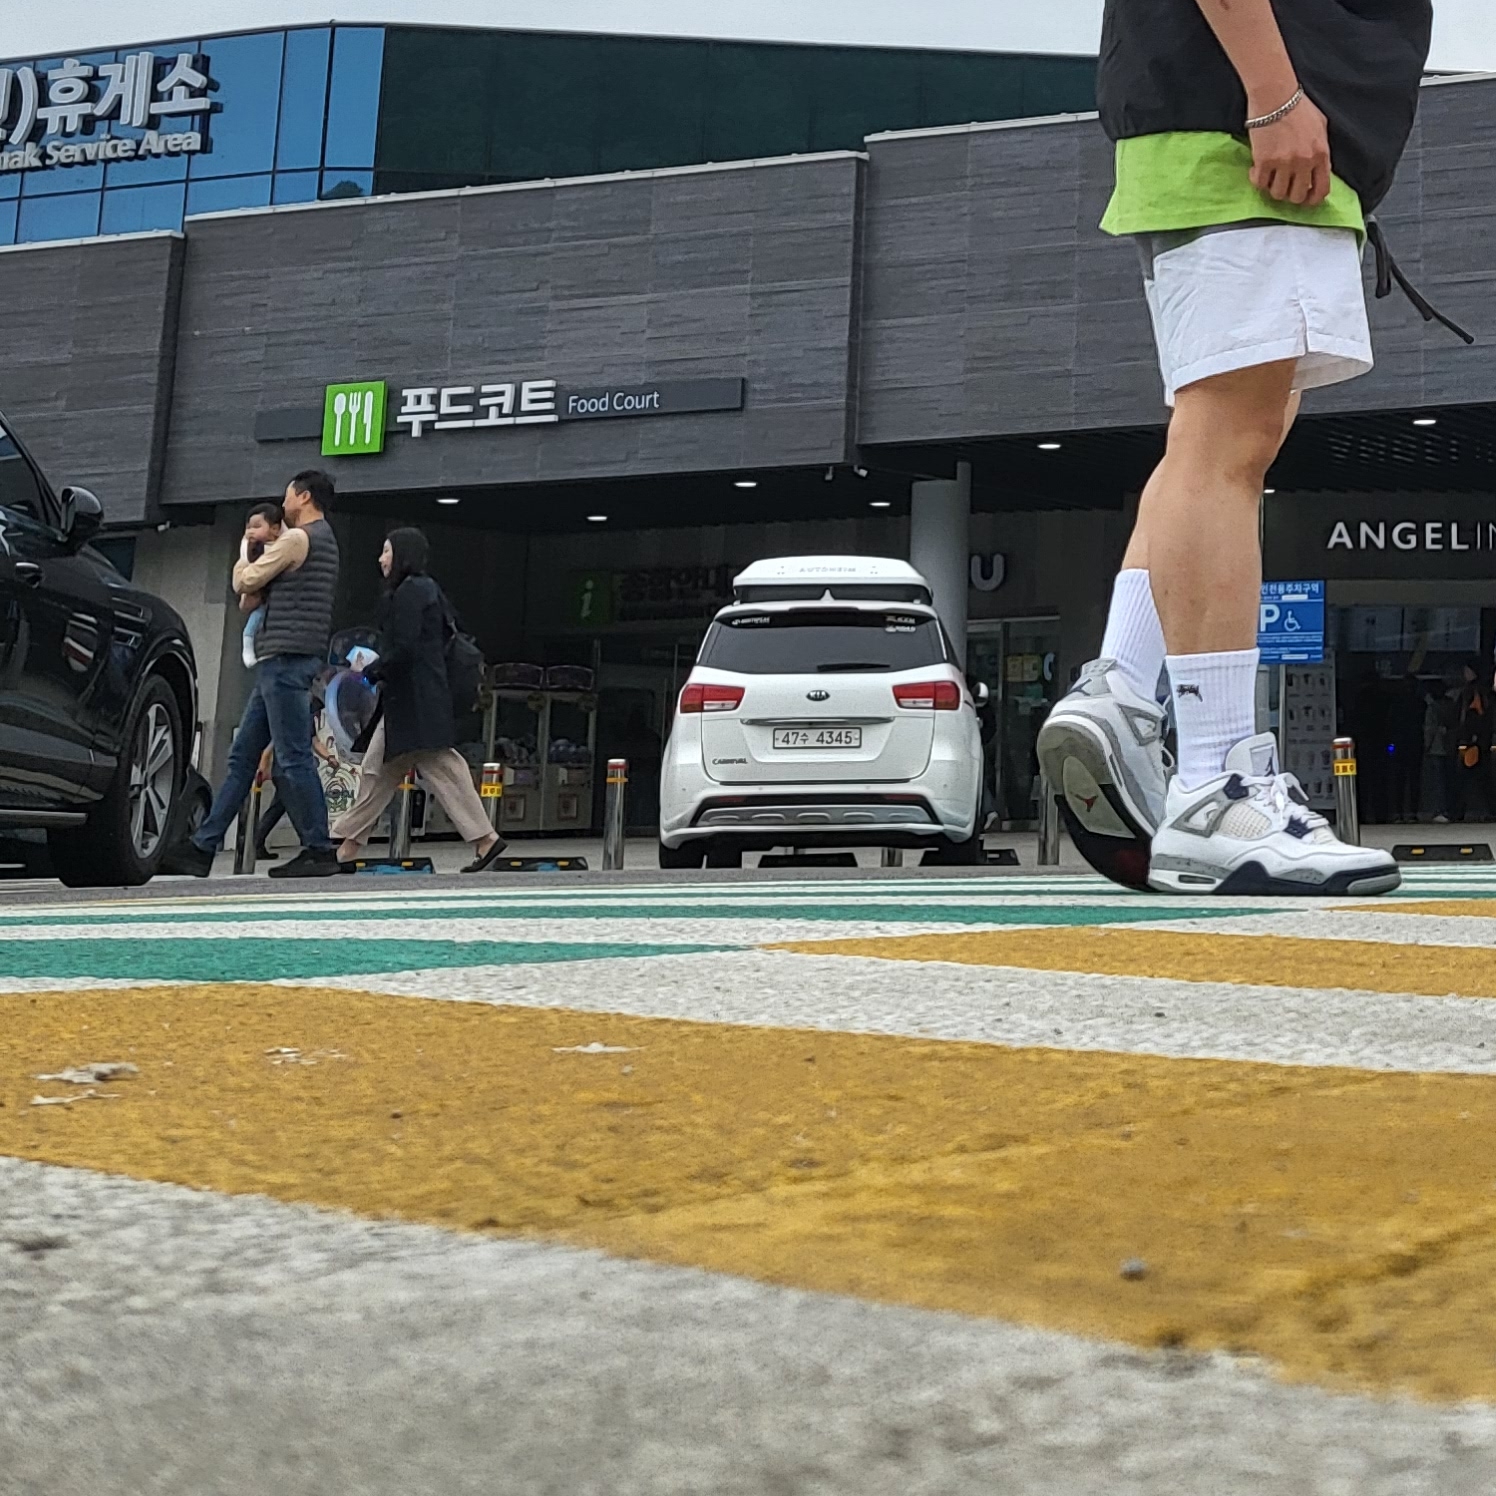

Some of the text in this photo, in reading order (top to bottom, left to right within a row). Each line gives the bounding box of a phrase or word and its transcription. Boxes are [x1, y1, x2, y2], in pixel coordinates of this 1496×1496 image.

[0, 52, 210, 145] )휴게소
[45, 134, 137, 165] Service
[138, 129, 201, 155] Area
[397, 380, 559, 437] 푸드코트
[568, 391, 660, 414] Food Court
[1260, 604, 1280, 632] P
[809, 691, 826, 699] KIA
[781, 731, 853, 745] 47수 4345
